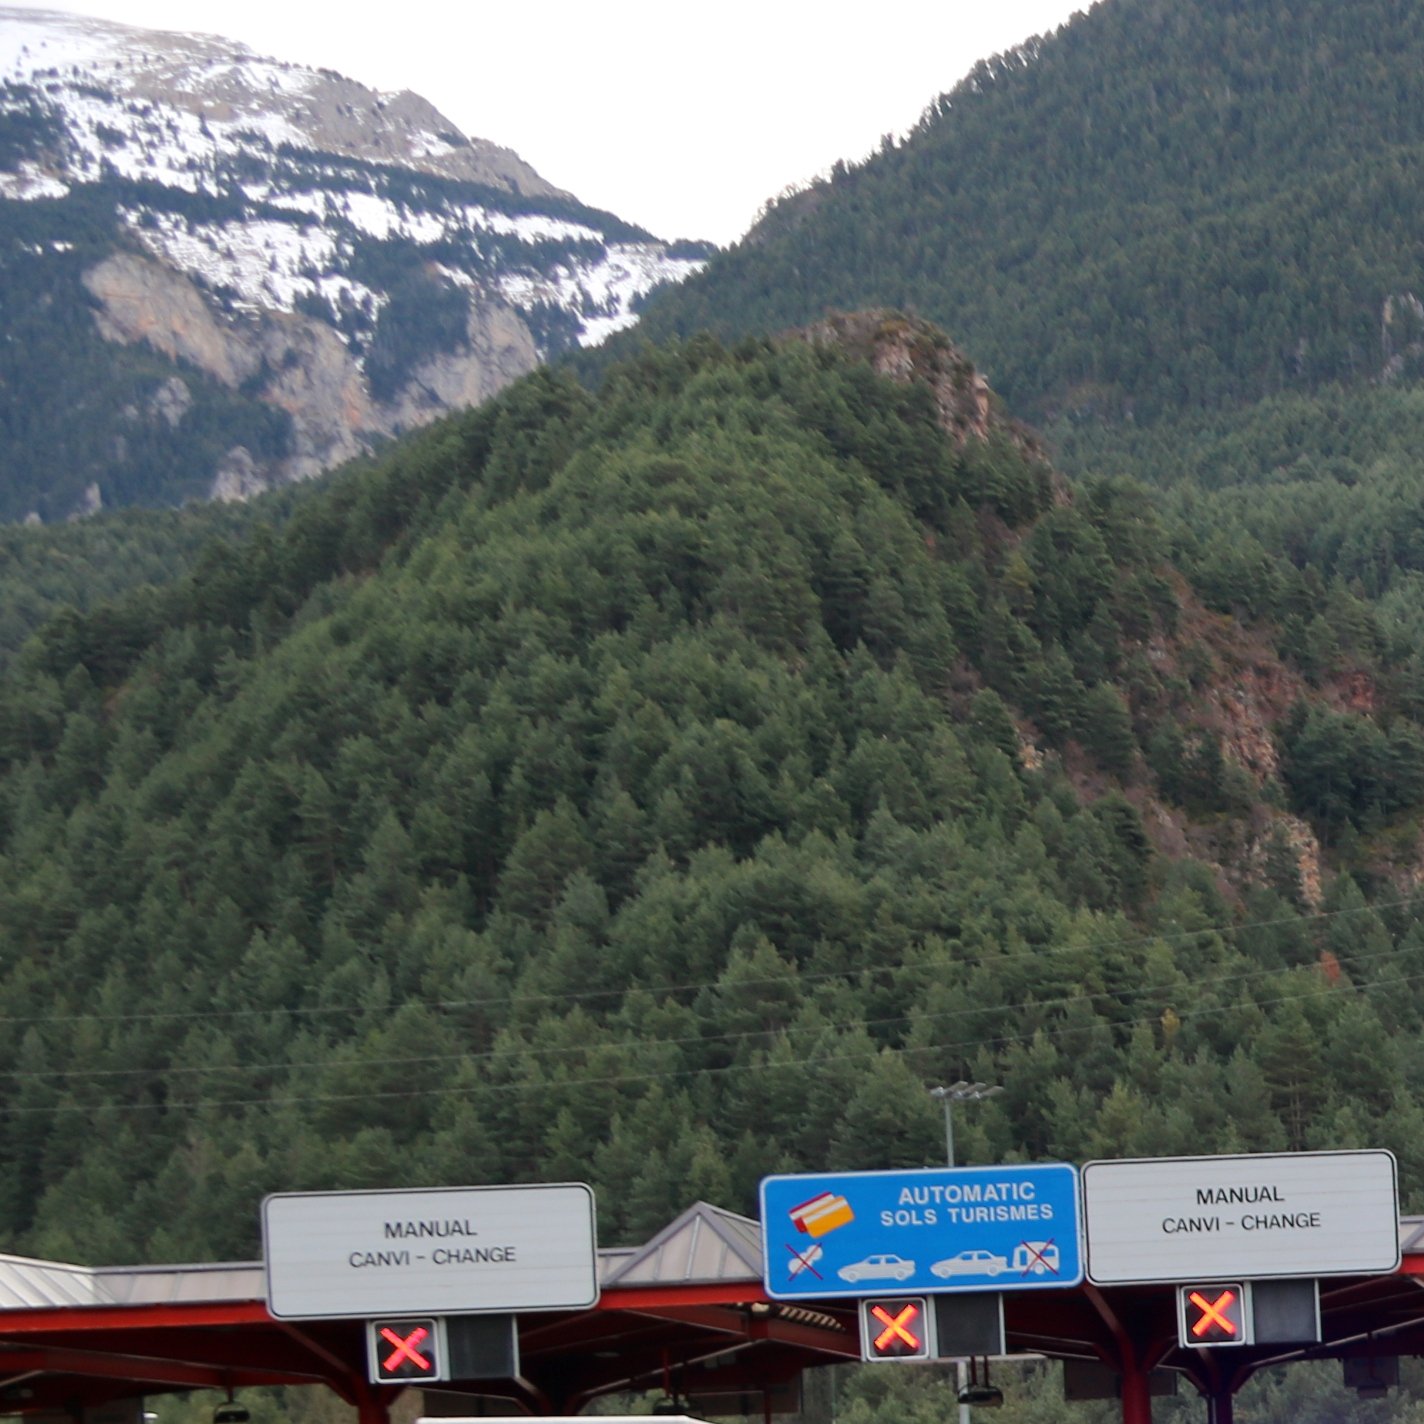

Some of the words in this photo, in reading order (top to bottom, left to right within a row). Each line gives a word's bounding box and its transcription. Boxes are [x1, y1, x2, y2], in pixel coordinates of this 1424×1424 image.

[898, 1181, 1036, 1205] AUTOMATIC
[1196, 1185, 1285, 1205] MANUAL
[880, 1208, 937, 1226] SOLS
[947, 1203, 1054, 1223] TURISMES
[1161, 1216, 1220, 1234] CANVI
[1241, 1212, 1321, 1231] CHANGE
[384, 1219, 478, 1239] MANUAL
[348, 1250, 410, 1268] CANVI
[432, 1246, 517, 1265] CHANGE
